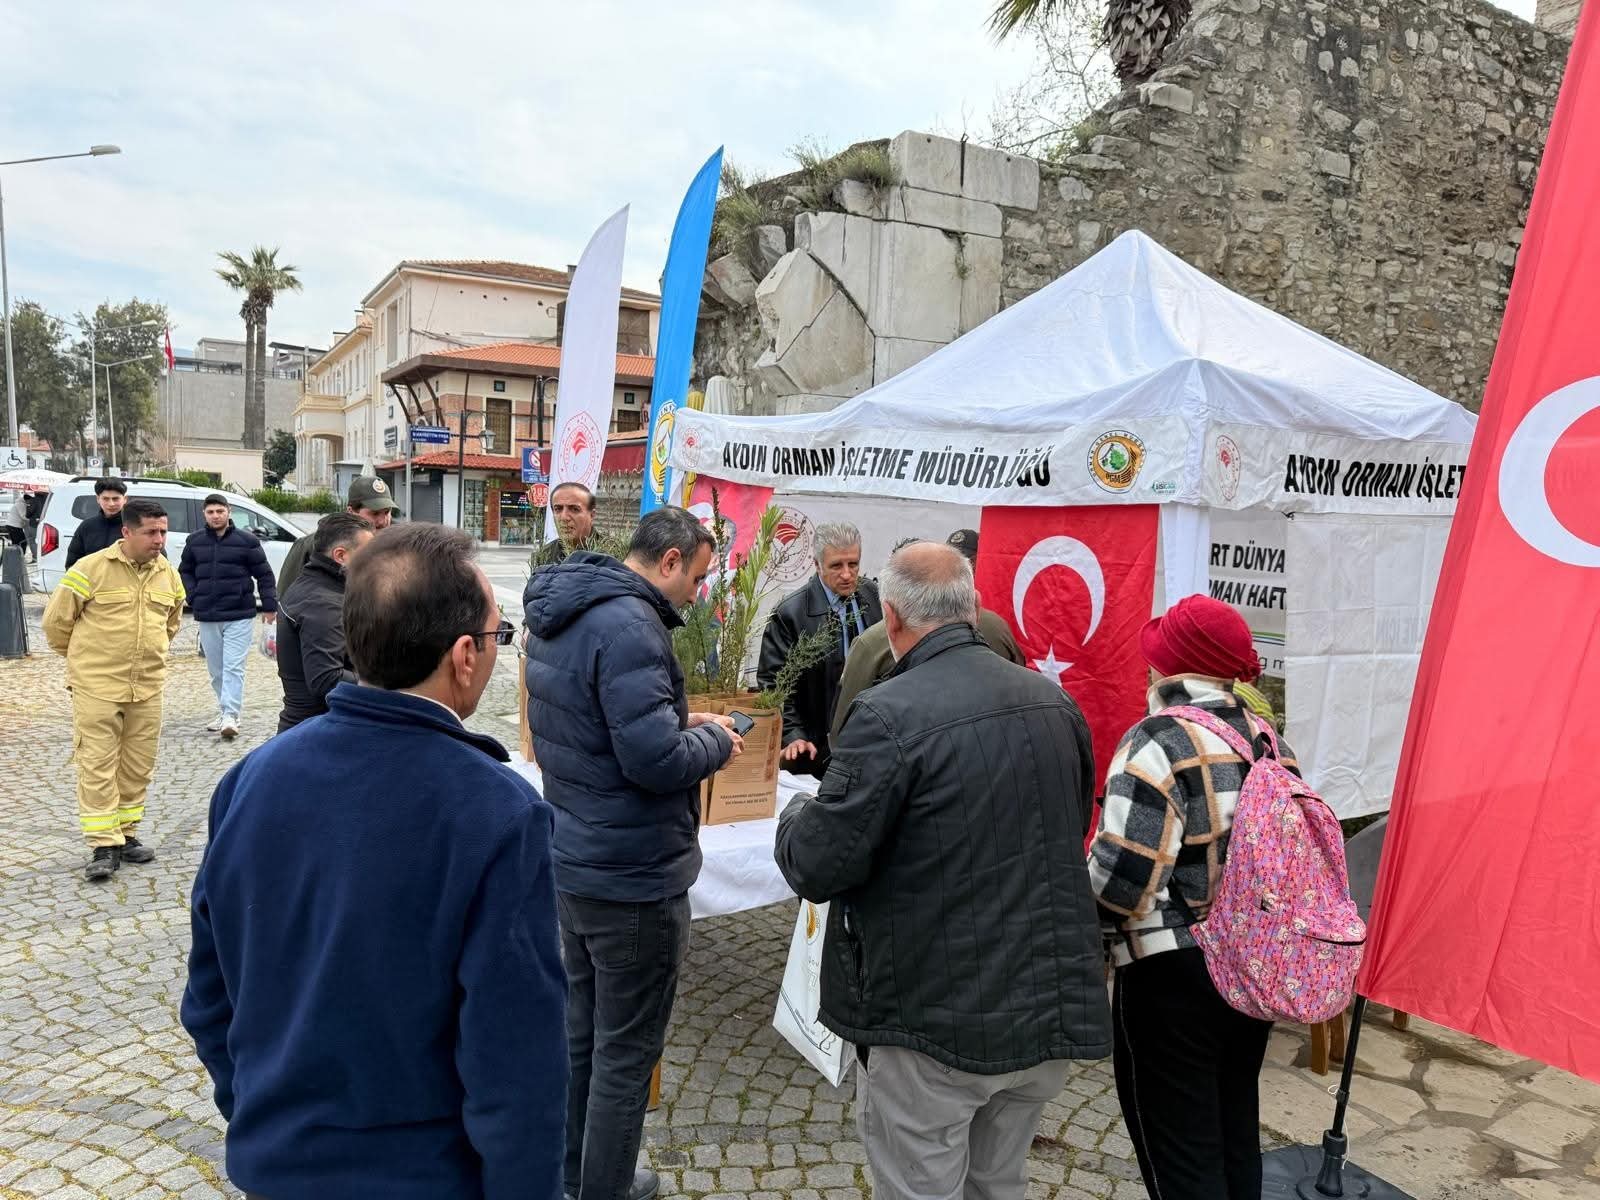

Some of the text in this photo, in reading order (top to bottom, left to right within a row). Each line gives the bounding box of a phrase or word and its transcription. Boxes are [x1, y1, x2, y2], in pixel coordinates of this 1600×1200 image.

[723, 441, 767, 473] AYDIN
[772, 443, 835, 477] ORMAN
[838, 440, 913, 481] İŞLETME
[913, 443, 1056, 489] MÜDÜRLÜĞÜ
[1284, 454, 1341, 497] AYDIN
[1342, 461, 1412, 499] ORMAN
[1416, 456, 1467, 504] İŞLET
[1210, 540, 1286, 573] RT DÜNYA
